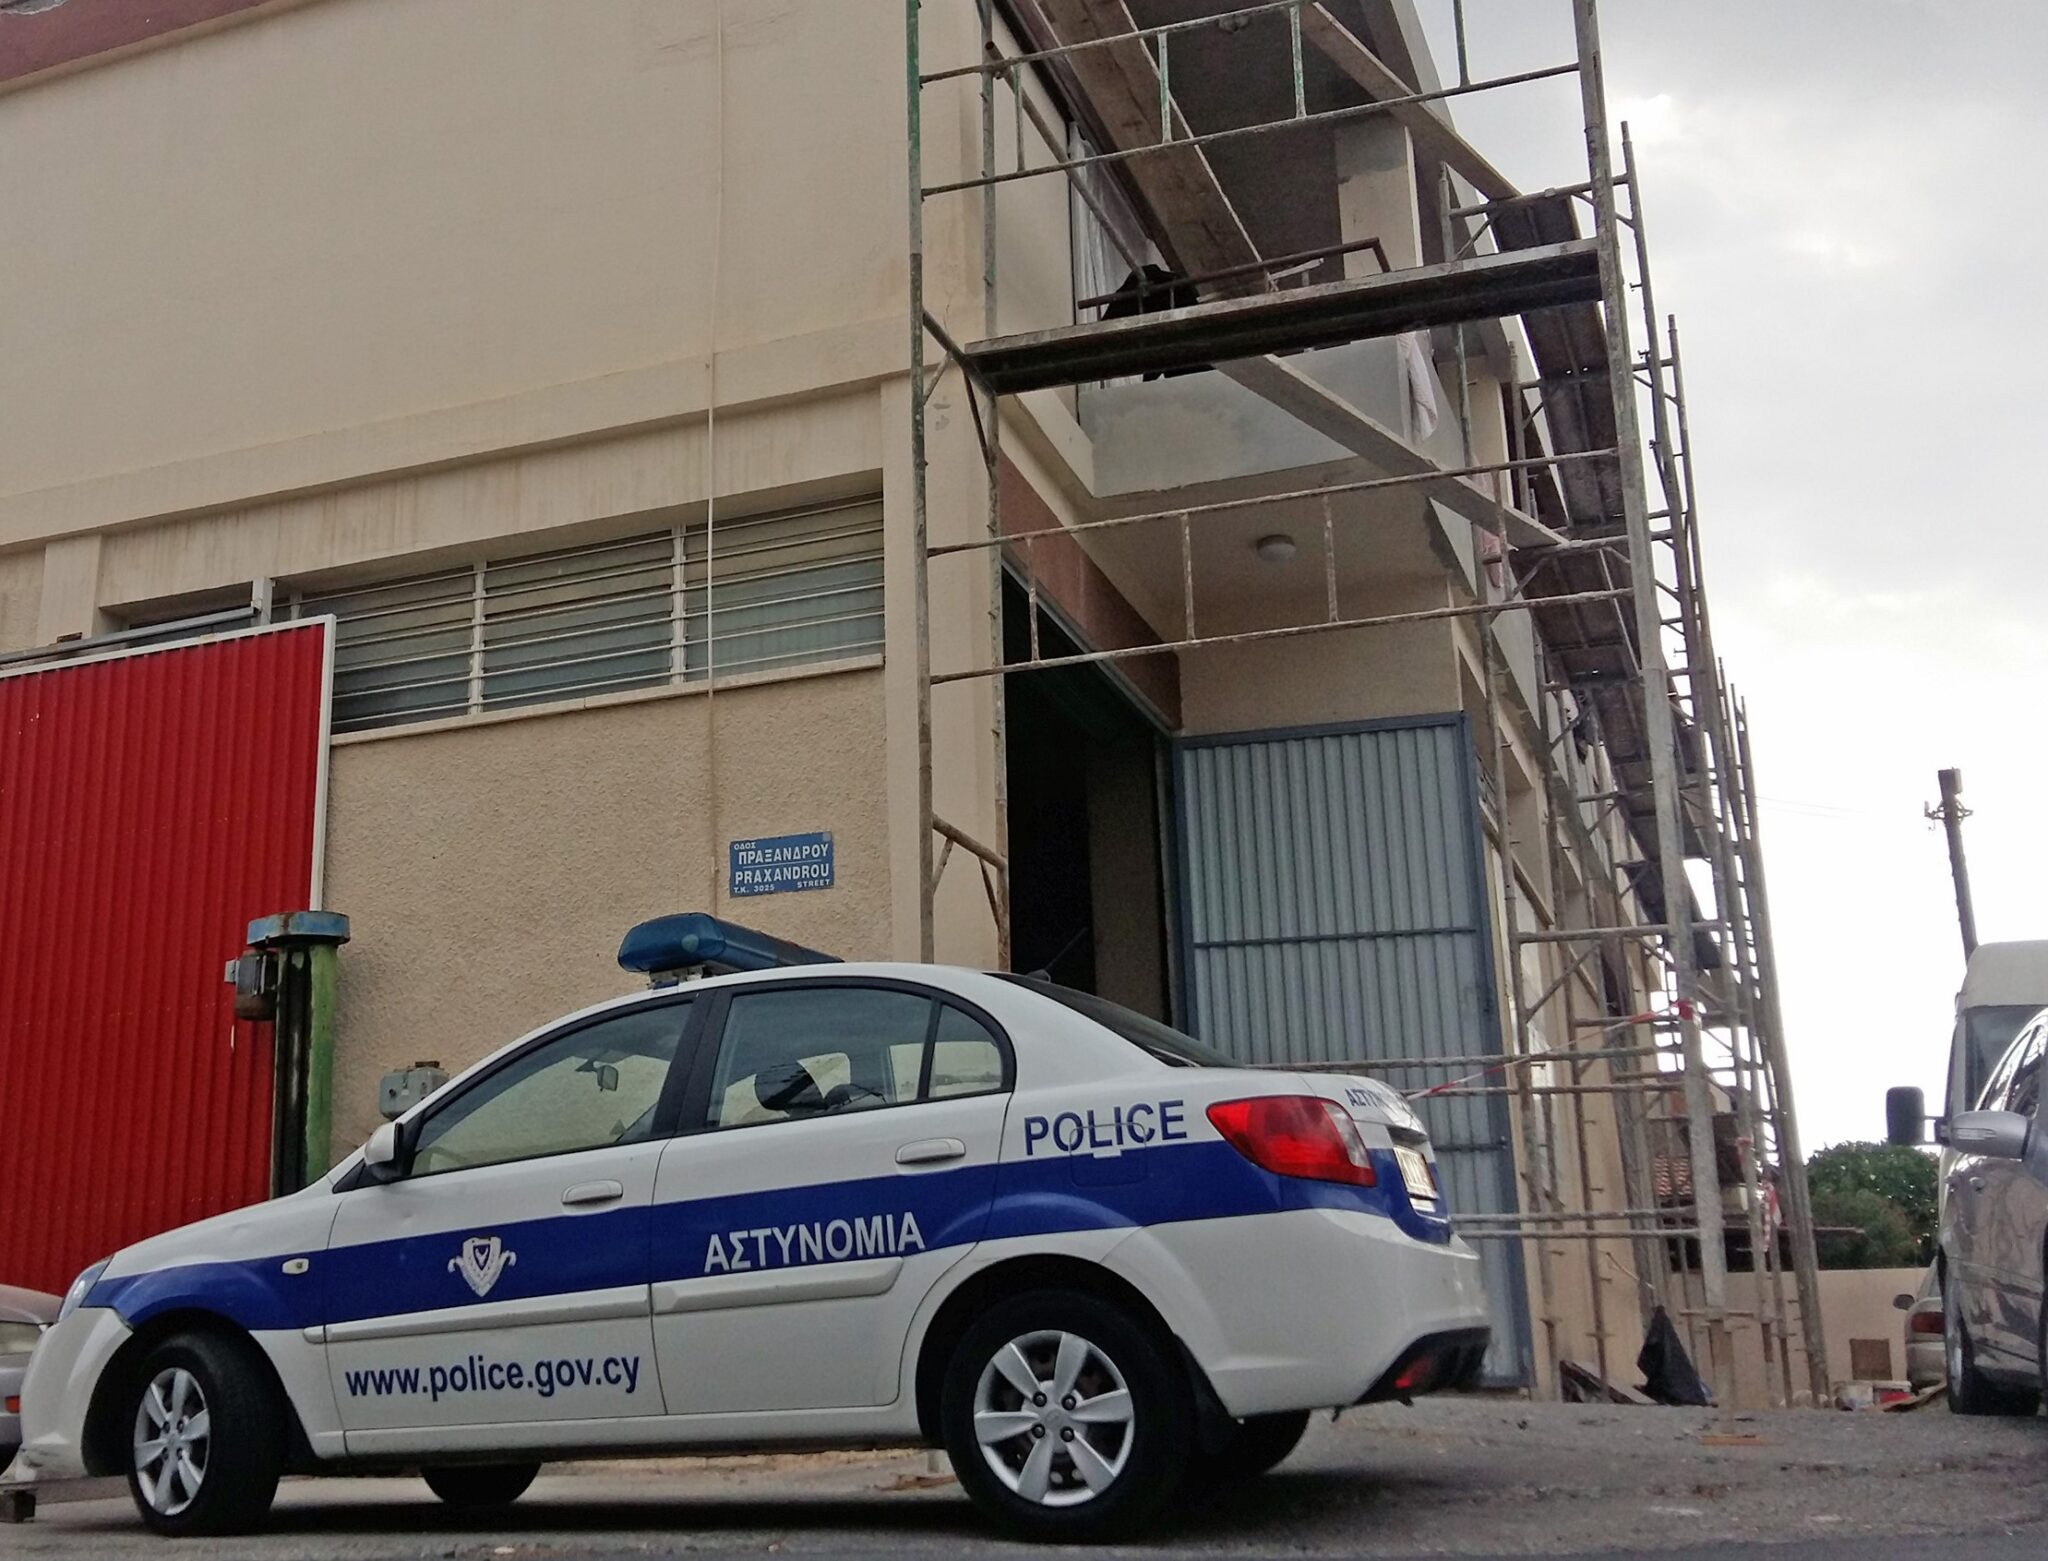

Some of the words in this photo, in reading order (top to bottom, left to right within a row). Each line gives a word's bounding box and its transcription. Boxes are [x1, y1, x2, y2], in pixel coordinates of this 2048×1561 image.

[734, 842, 757, 851] ΟΔΟΣ
[738, 843, 829, 865] ΠΡΑΞΑΝΔΡΟΥ
[735, 863, 829, 885] PRAXANDROU
[797, 879, 830, 888] STREET
[1023, 1100, 1188, 1156] POLICE
[703, 1211, 926, 1274] ΑΣΤΥΝΟΜΙΑ
[345, 1356, 640, 1402] www.police.gov.cy
